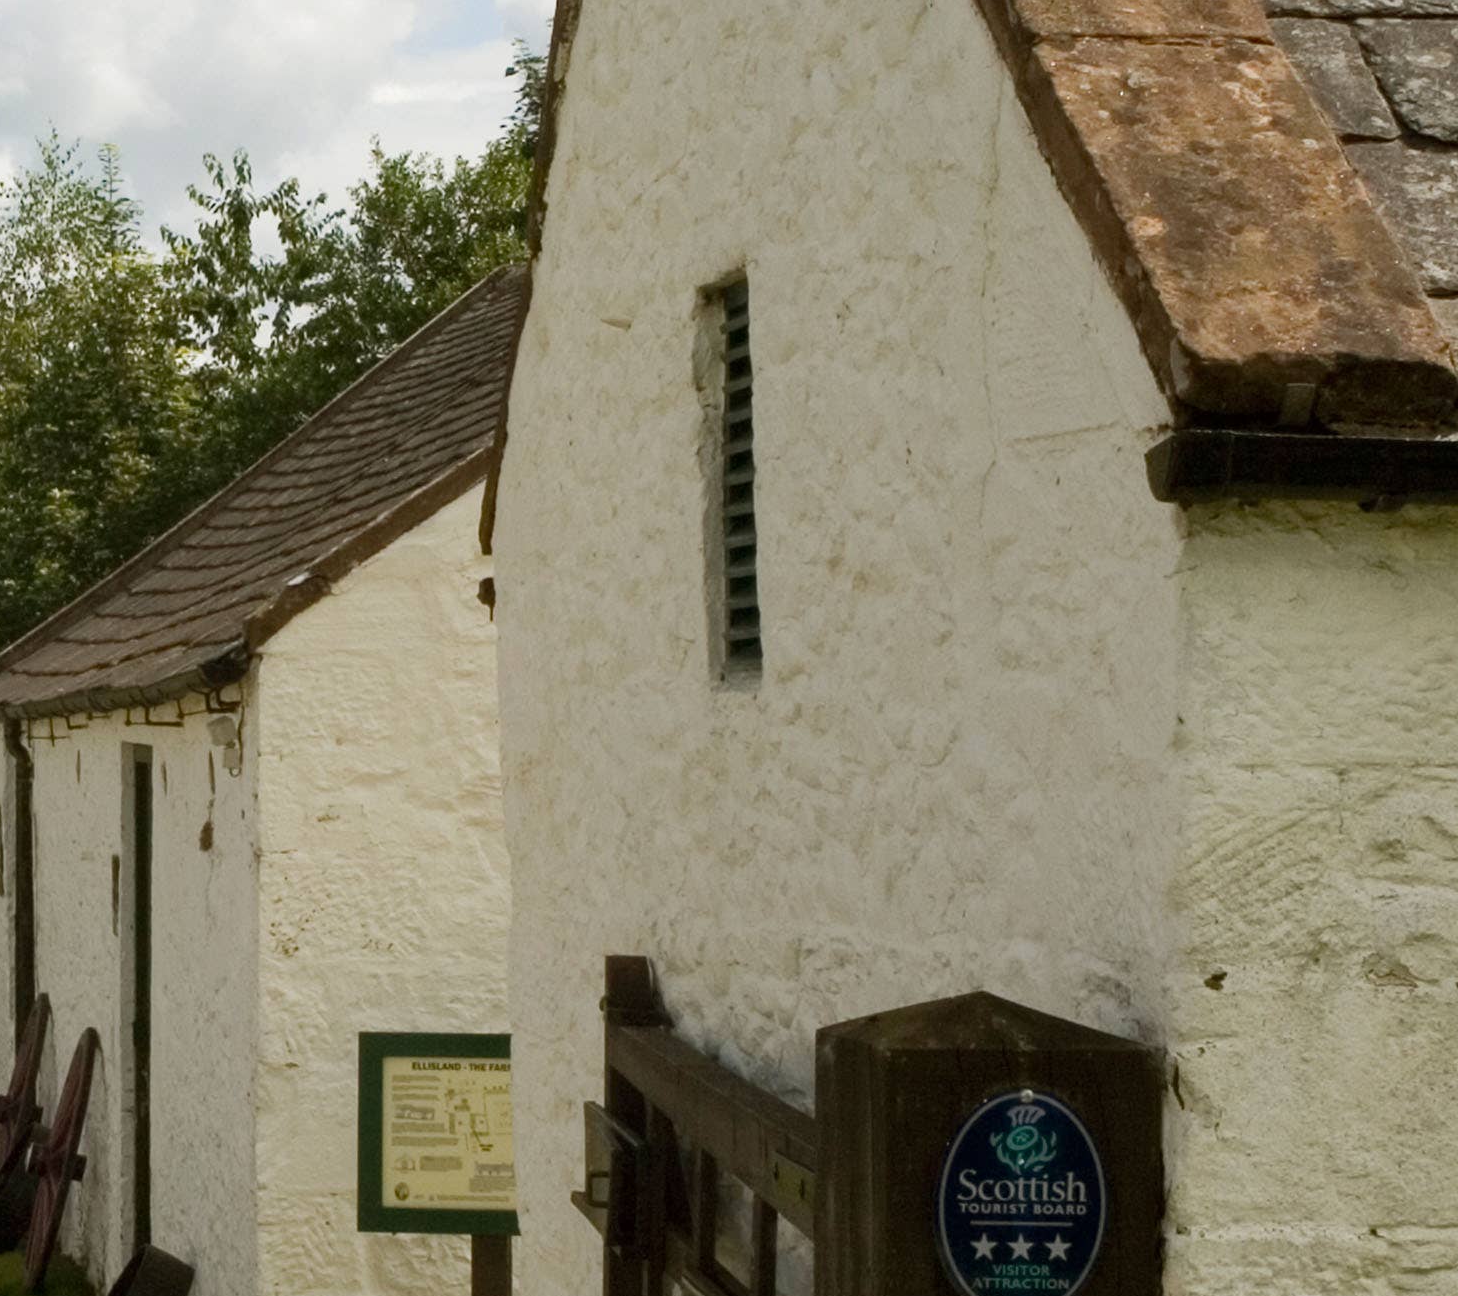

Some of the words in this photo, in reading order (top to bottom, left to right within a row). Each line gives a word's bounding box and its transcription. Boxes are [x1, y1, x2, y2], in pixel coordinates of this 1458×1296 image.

[411, 1061, 461, 1071] ELLISLAND
[468, 1063, 487, 1072] THE
[957, 1169, 1087, 1202] Scottish
[958, 1203, 1027, 1214] TOURIST
[1032, 1204, 1087, 1215] BOARD
[992, 1264, 1050, 1276] VISITOR
[971, 1277, 1070, 1289] ATTRACTION
